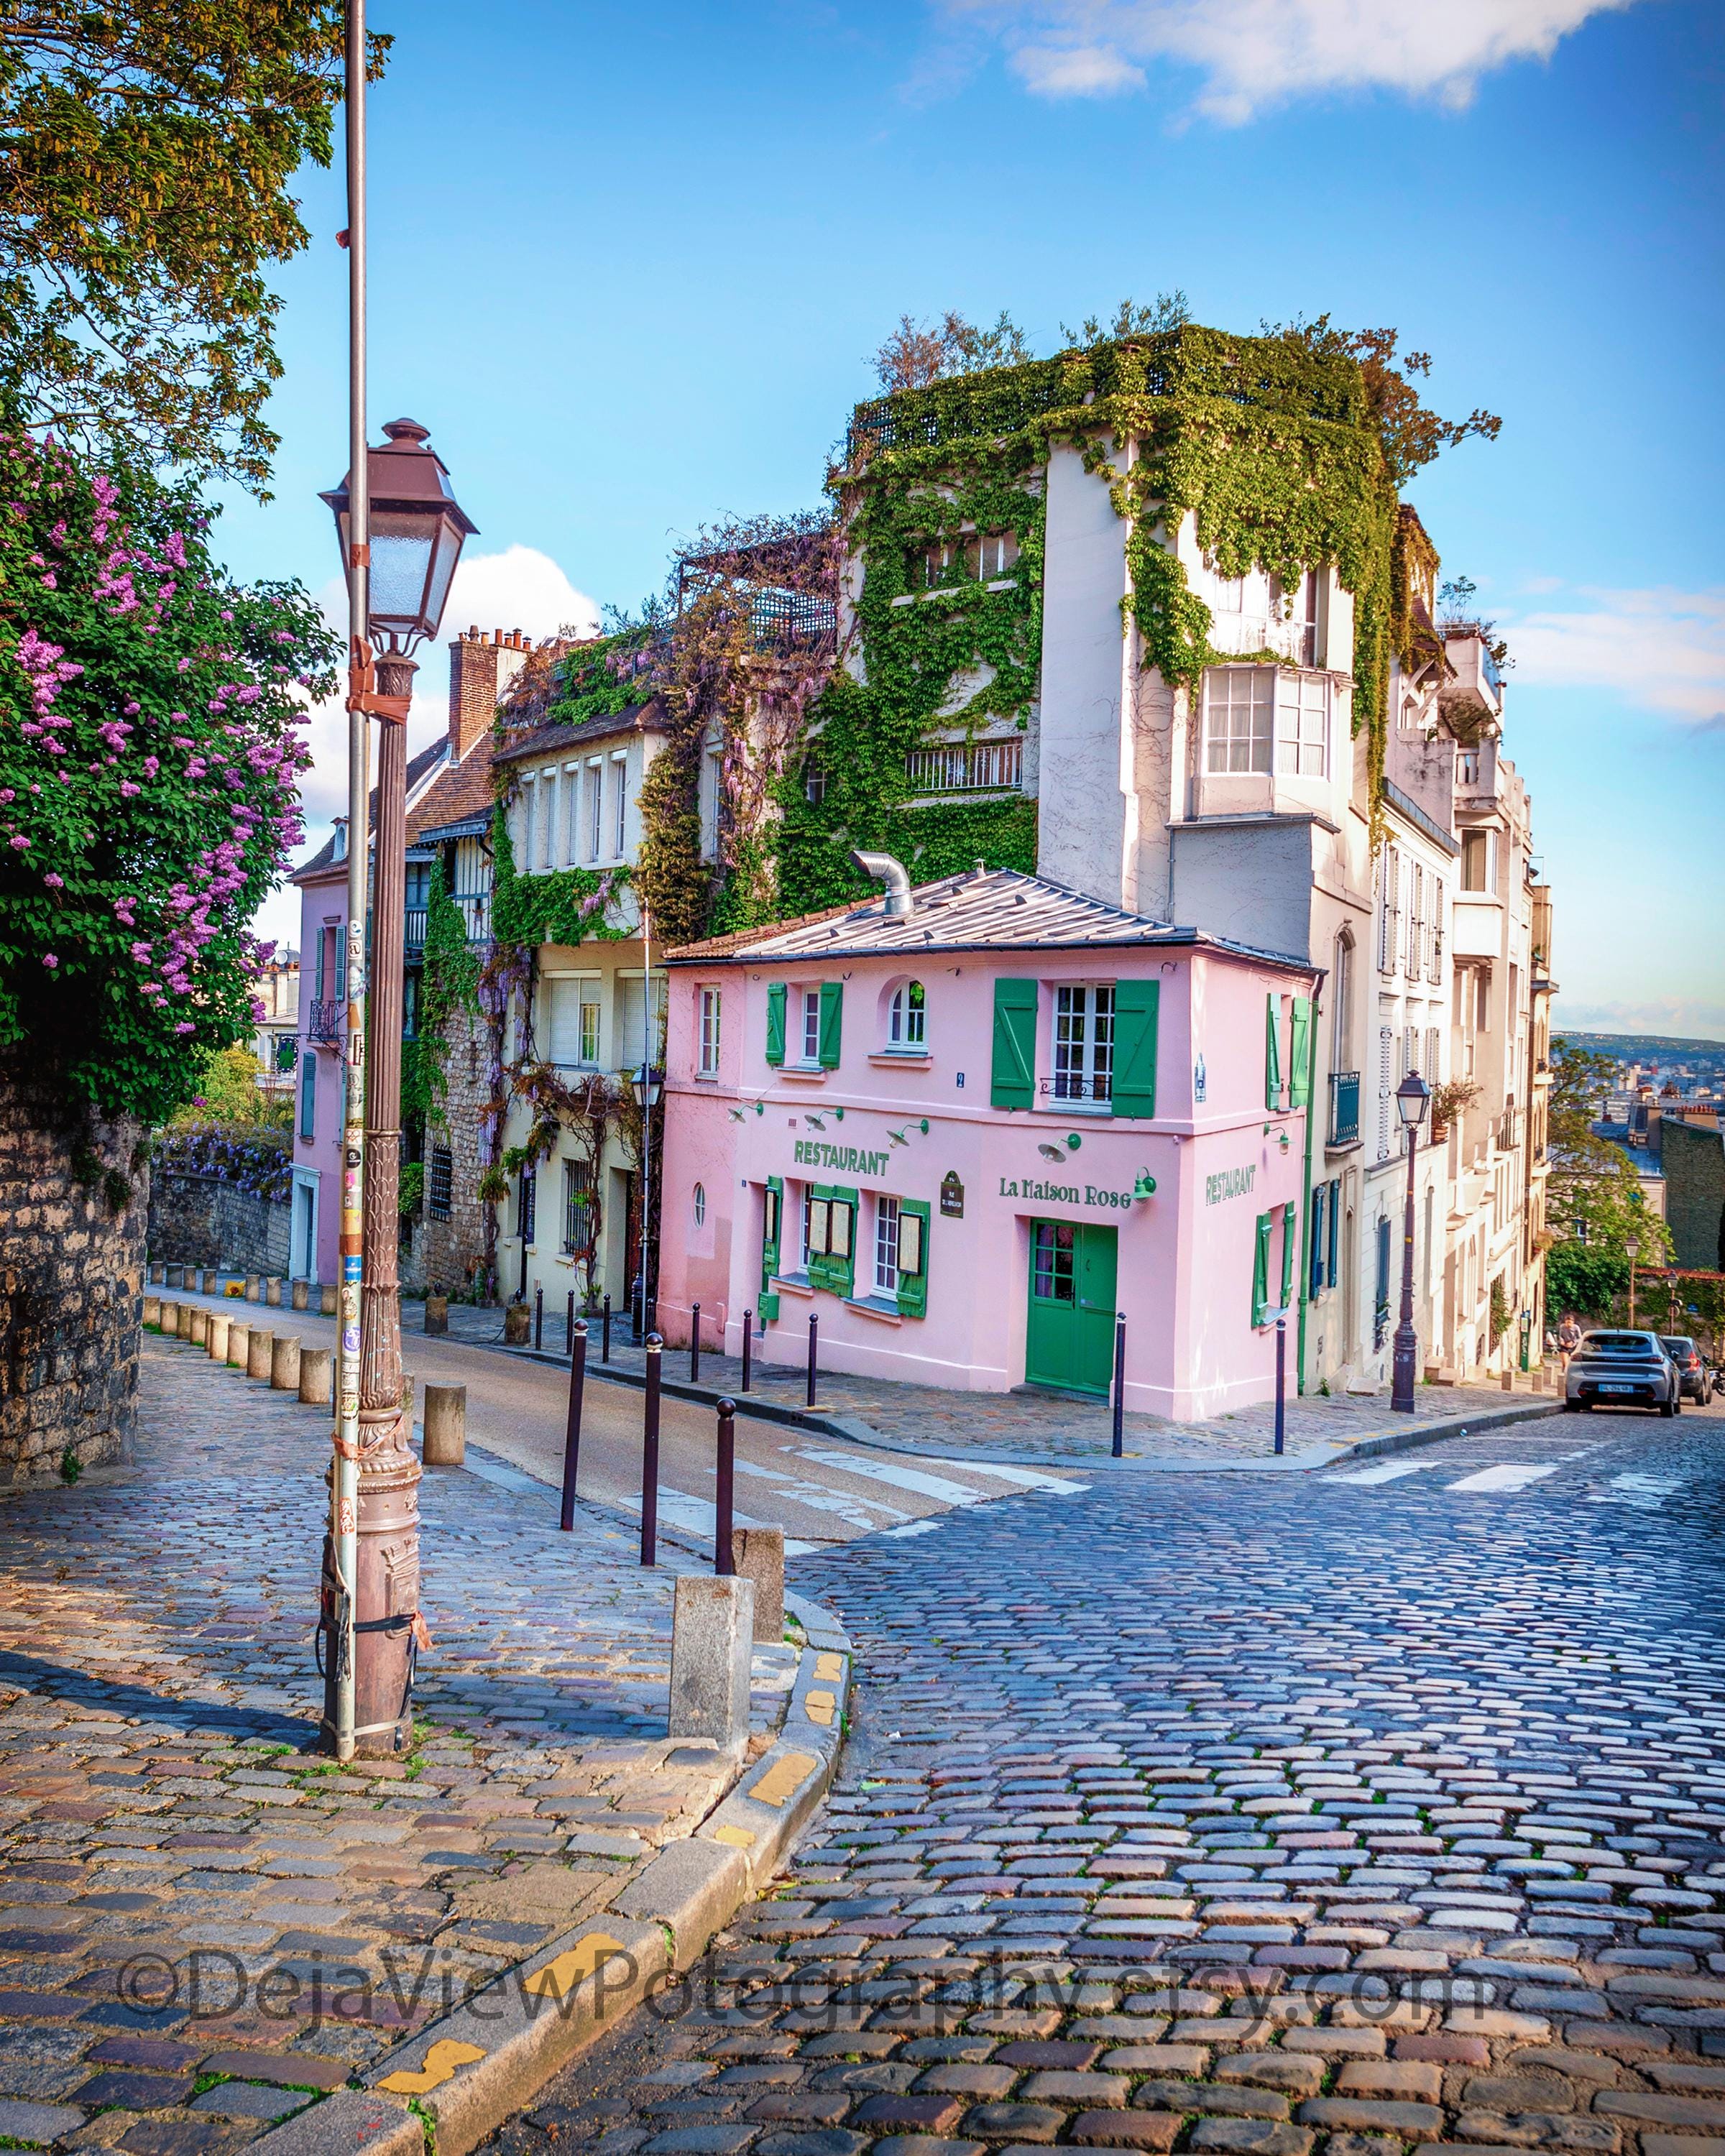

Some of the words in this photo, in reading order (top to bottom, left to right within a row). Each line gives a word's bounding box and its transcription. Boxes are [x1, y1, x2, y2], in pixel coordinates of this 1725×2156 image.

[794, 1140, 890, 1176] RESTAURANT
[999, 1177, 1018, 1197] La
[1021, 1179, 1080, 1204] Maison
[1084, 1185, 1131, 1210] Rose
[1206, 1164, 1256, 1207] RESTAURANT
